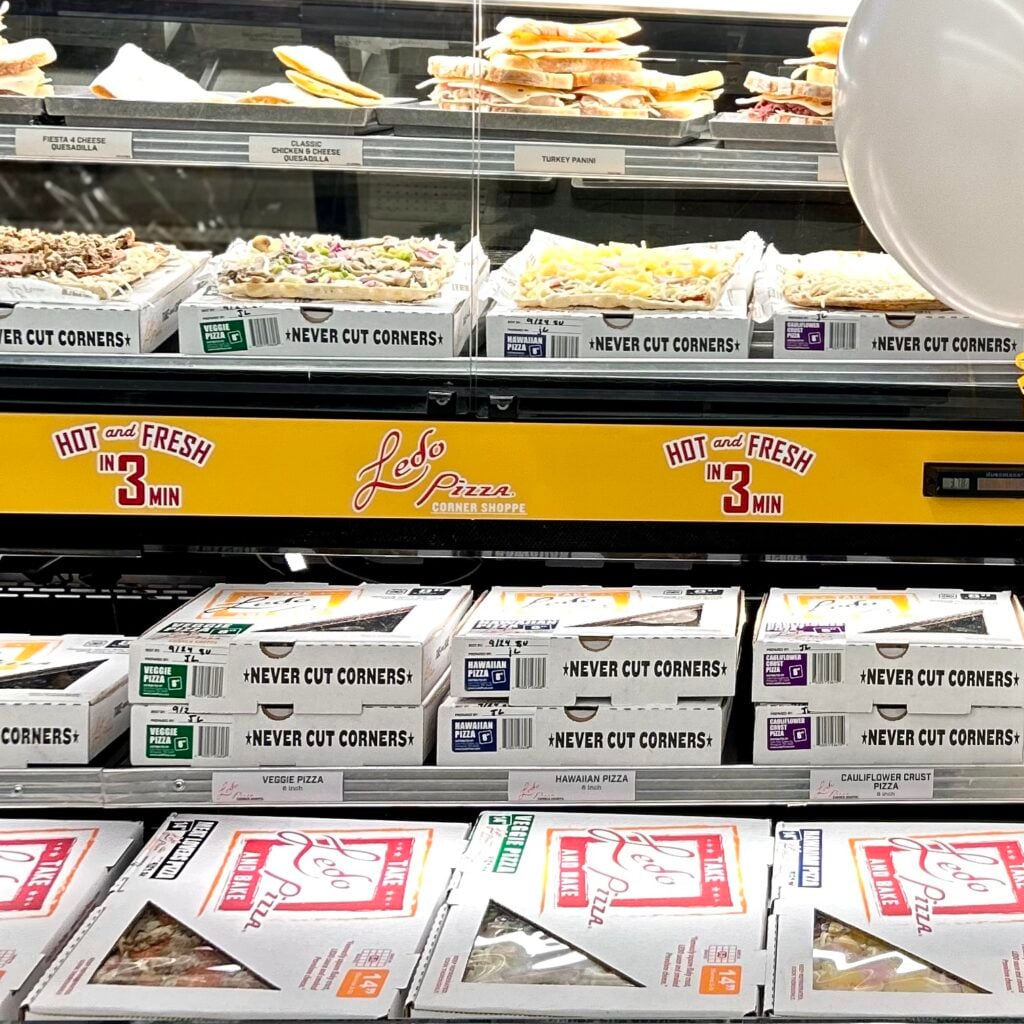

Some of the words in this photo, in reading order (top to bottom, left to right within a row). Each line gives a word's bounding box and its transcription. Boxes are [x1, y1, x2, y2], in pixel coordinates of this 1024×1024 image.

[51, 143, 98, 152] QUESADILLA
[77, 136, 106, 145] CHEESE
[291, 139, 322, 148] CLASSIC
[312, 148, 341, 157] CHEESE
[542, 155, 571, 163] TURKEY
[572, 156, 596, 164] PANINI
[292, 326, 339, 344] NEVER
[343, 327, 369, 345] CUT
[372, 328, 437, 346] CORNERS
[595, 336, 640, 352] NEVER
[643, 337, 670, 352] CUT
[672, 337, 734, 353] CORNERS
[55, 425, 99, 457] HOT
[105, 424, 136, 439] and
[142, 425, 212, 464] FRESH
[665, 436, 707, 466] HOT
[714, 434, 743, 449] and
[747, 434, 814, 473] FRESH
[353, 428, 445, 511] Ledo
[100, 454, 115, 472] IN
[118, 454, 145, 506] 3
[149, 486, 180, 506] MIN
[415, 474, 513, 506] Pizza
[707, 464, 721, 481] IN
[723, 464, 750, 514] 3
[752, 495, 782, 514] MIN
[432, 502, 477, 513] CORNER
[481, 503, 526, 514] SHOPPE
[250, 666, 300, 684] NEVER
[304, 667, 334, 685] CUT
[337, 667, 406, 685] CORNERS
[569, 660, 618, 677] NEVER
[622, 660, 650, 677] CUT
[653, 660, 720, 677] CORNERS
[867, 668, 913, 686] NEVER
[917, 669, 944, 686] CUT
[948, 669, 1013, 687] CORNERS
[262, 775, 295, 785] VEGGIE
[297, 775, 323, 784] PIZZA
[555, 775, 600, 784] HAWAIIAN
[602, 775, 628, 784] PIZZA
[841, 773, 902, 782] CAULIFLOWER
[903, 773, 931, 782] CRUST
[873, 782, 899, 791] PIZZA
[704, 856, 726, 883] TAKE
